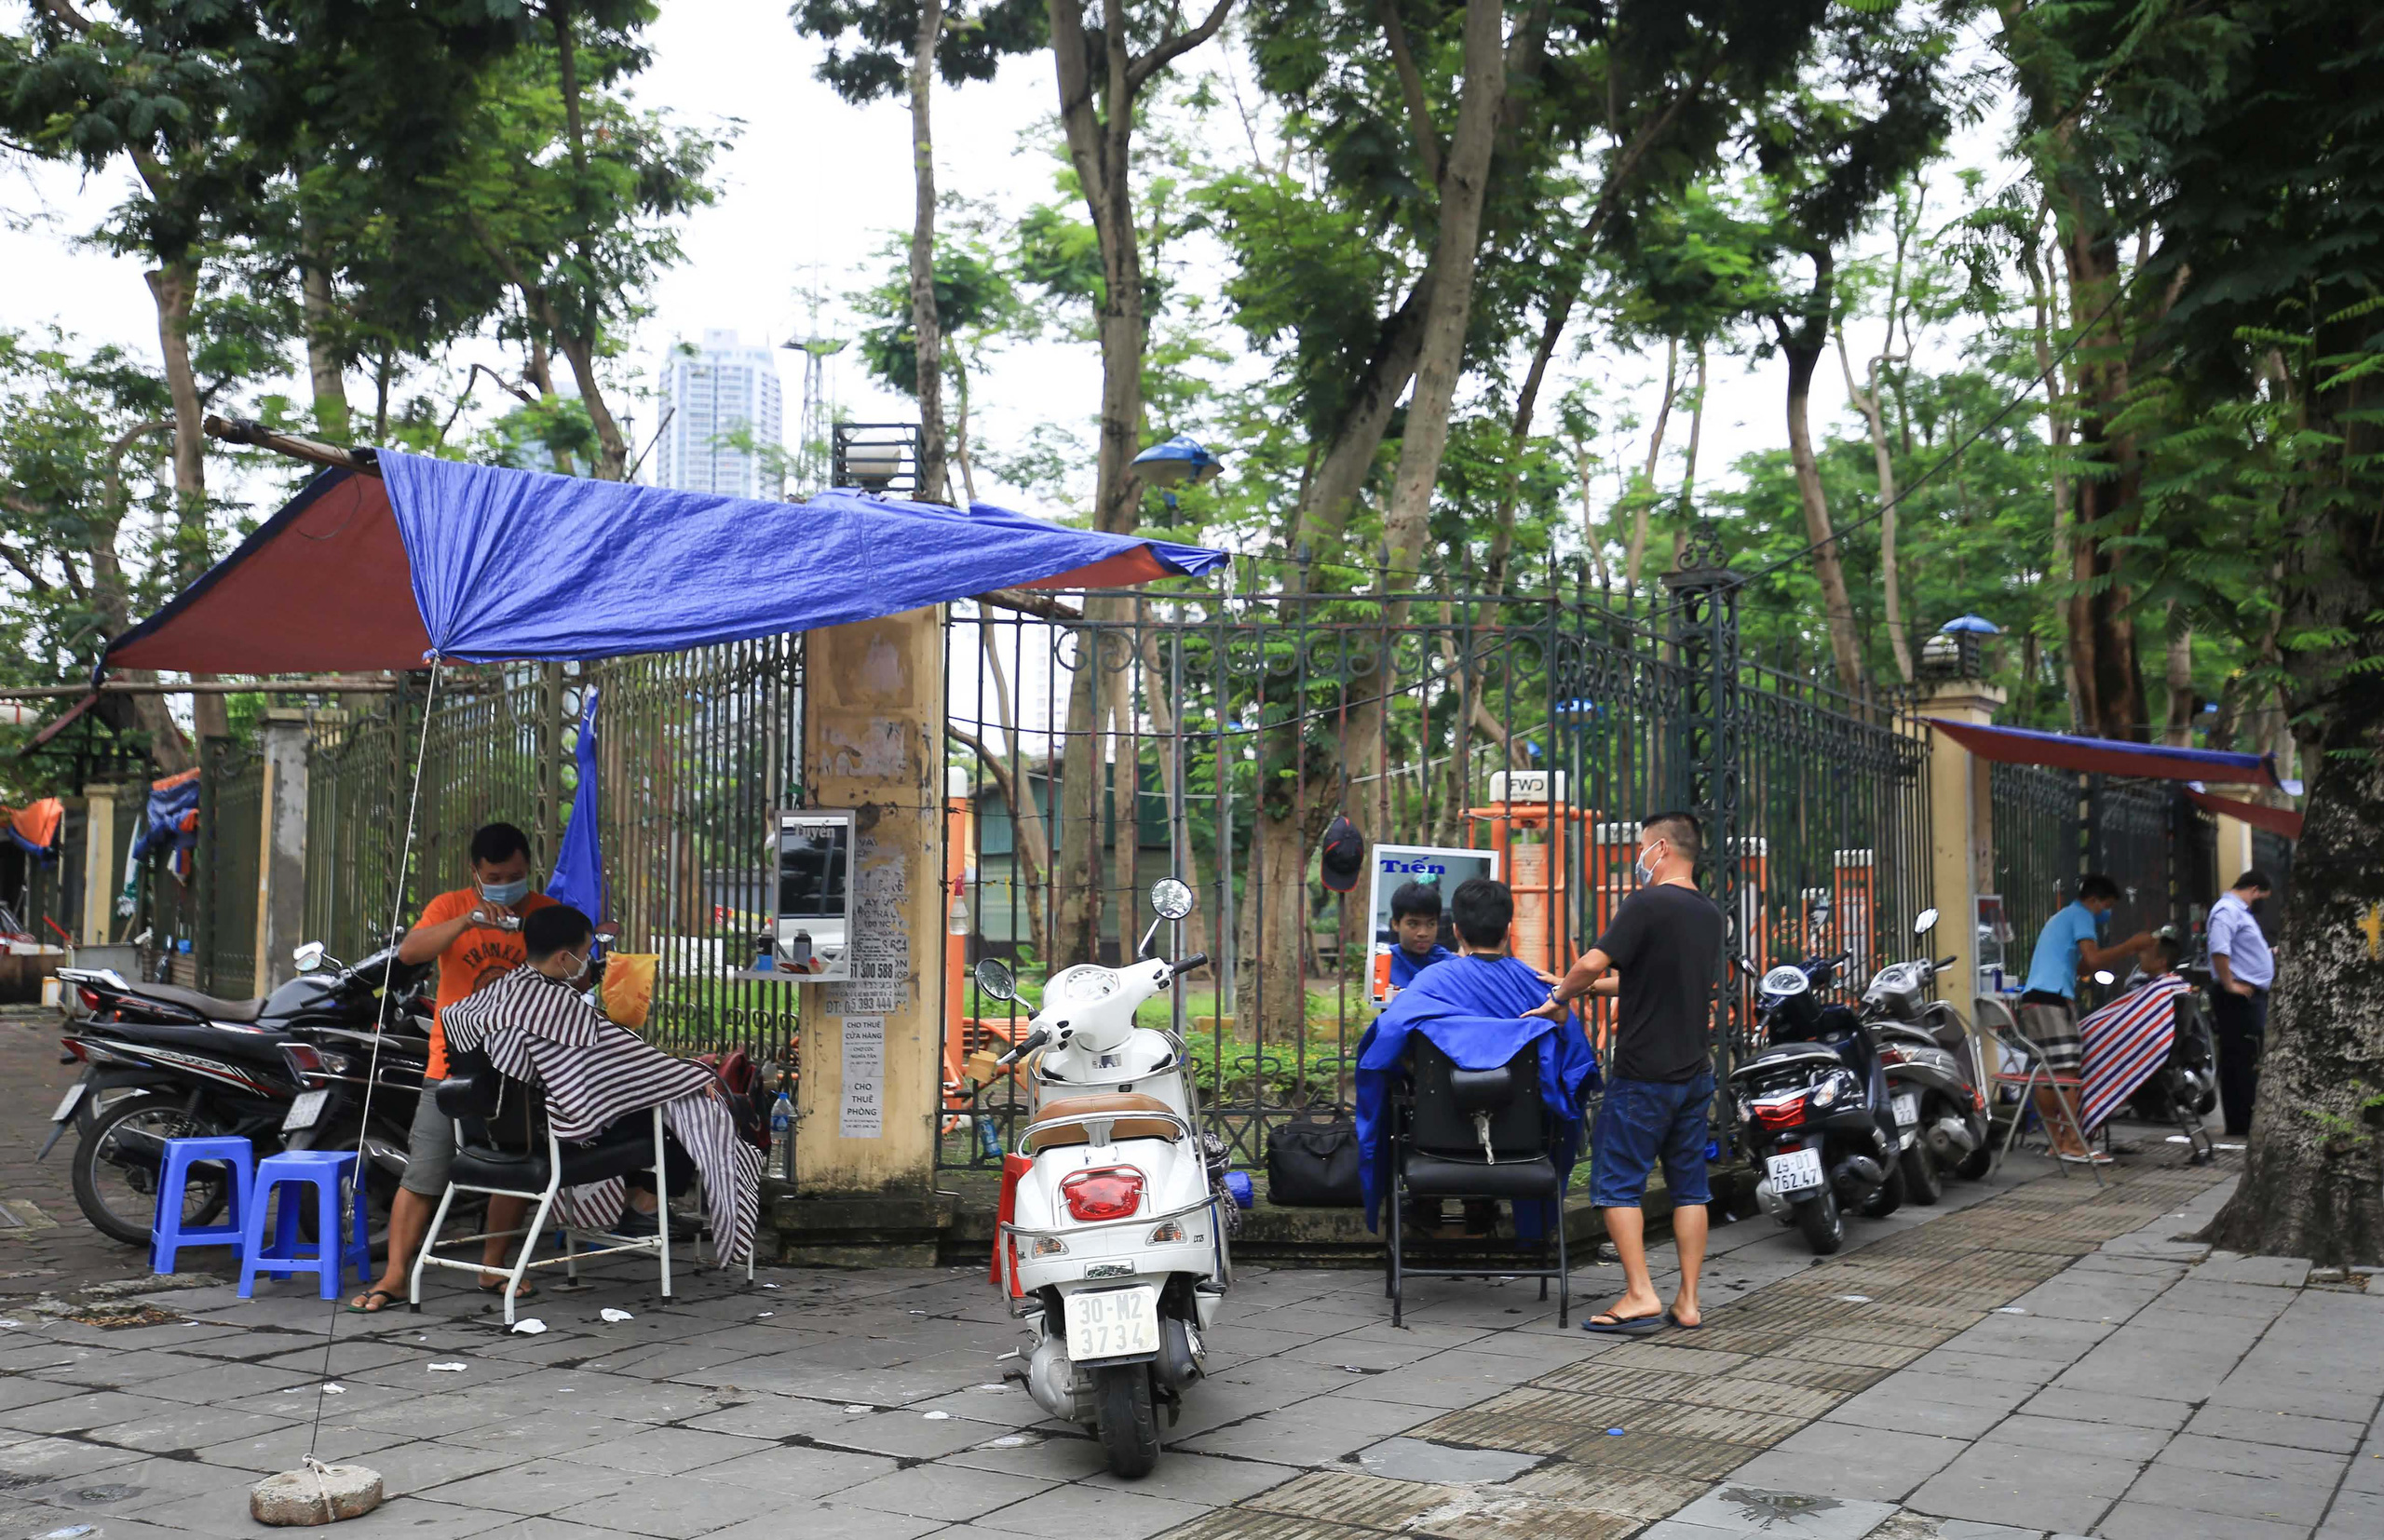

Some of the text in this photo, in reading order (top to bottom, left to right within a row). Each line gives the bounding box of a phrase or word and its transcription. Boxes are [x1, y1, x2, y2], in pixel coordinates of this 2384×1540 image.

[860, 963, 876, 979] 300
[877, 963, 893, 979] 588
[858, 997, 874, 1010] 393
[875, 997, 892, 1009] 444
[861, 1032, 883, 1040] HÀNG
[854, 1083, 872, 1091] CHO
[851, 1095, 874, 1103] THUÊ
[847, 1106, 877, 1116] PHÒNG
[1080, 1322, 1145, 1355] 3734
